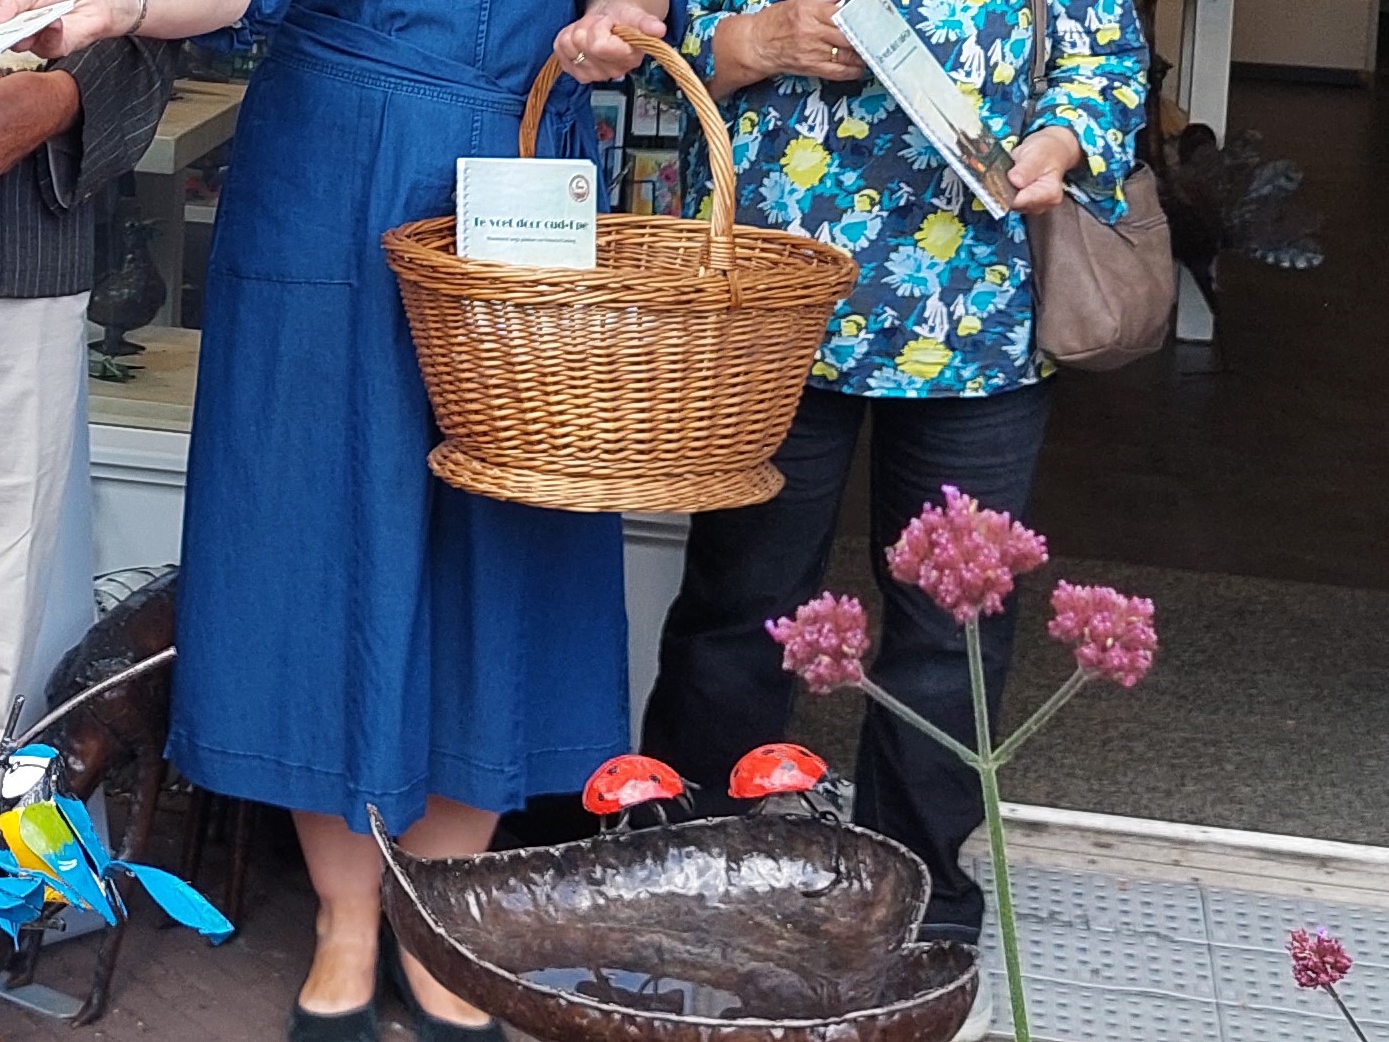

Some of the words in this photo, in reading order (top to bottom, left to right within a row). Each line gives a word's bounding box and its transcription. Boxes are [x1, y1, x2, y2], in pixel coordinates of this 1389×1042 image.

[474, 217, 487, 228] Te
[490, 217, 514, 228] voet
[516, 218, 542, 229] door
[544, 219, 589, 231] oud-Epe
